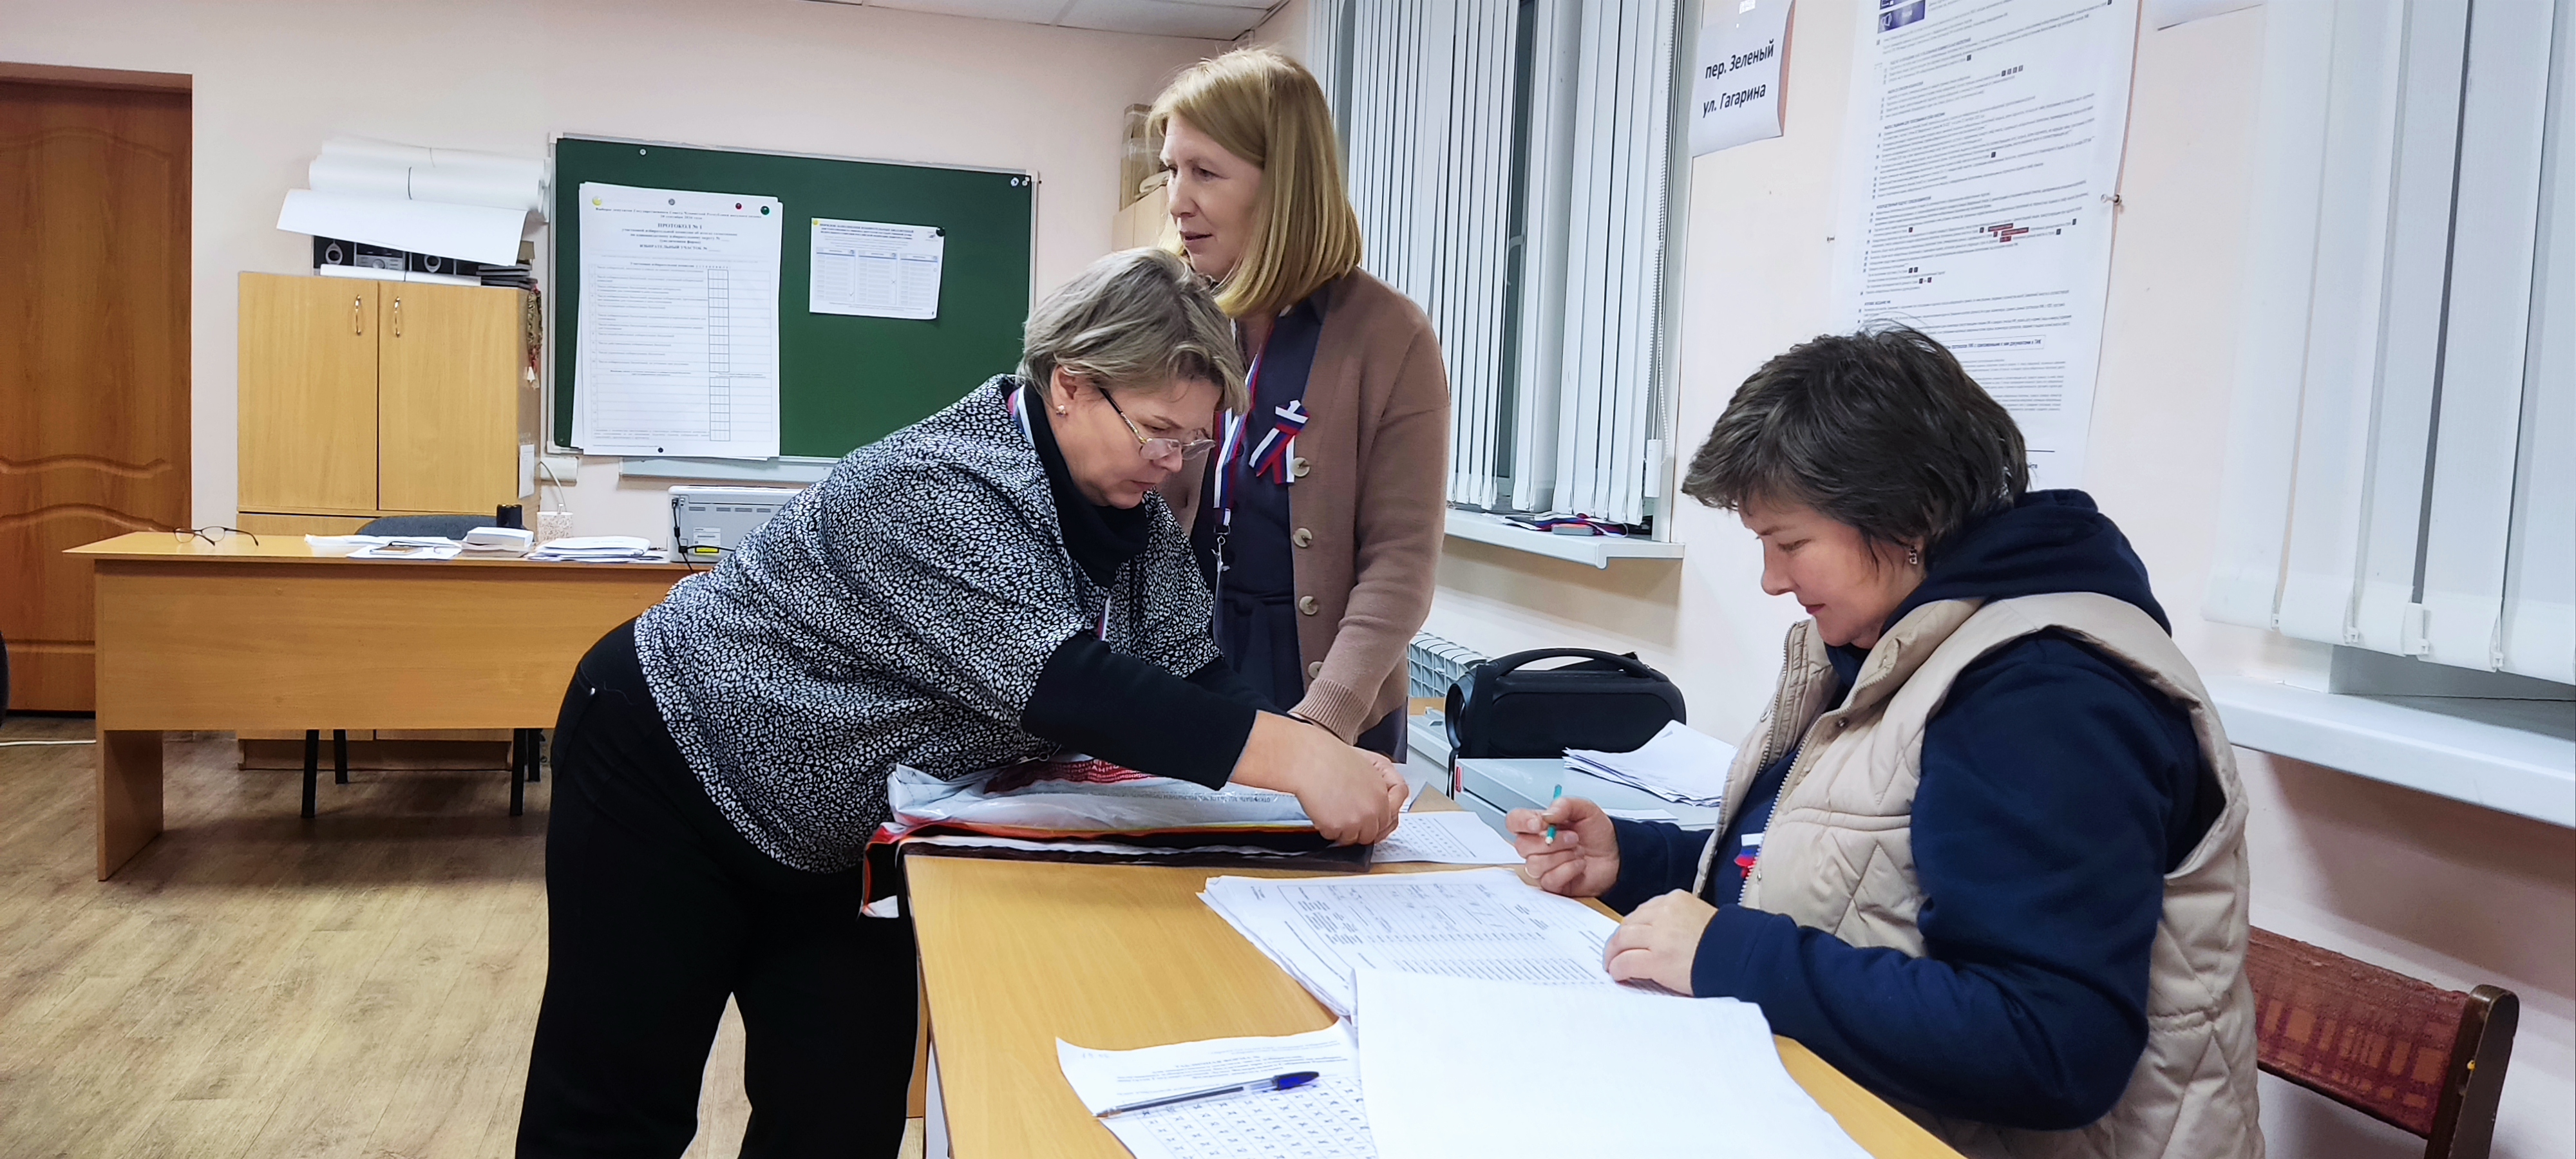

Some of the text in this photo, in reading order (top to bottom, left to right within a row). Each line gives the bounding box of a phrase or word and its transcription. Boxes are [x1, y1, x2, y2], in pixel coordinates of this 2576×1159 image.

[1705, 38, 1774, 79] пер. Зеленый
[1703, 84, 1766, 118] ул. Гагарина
